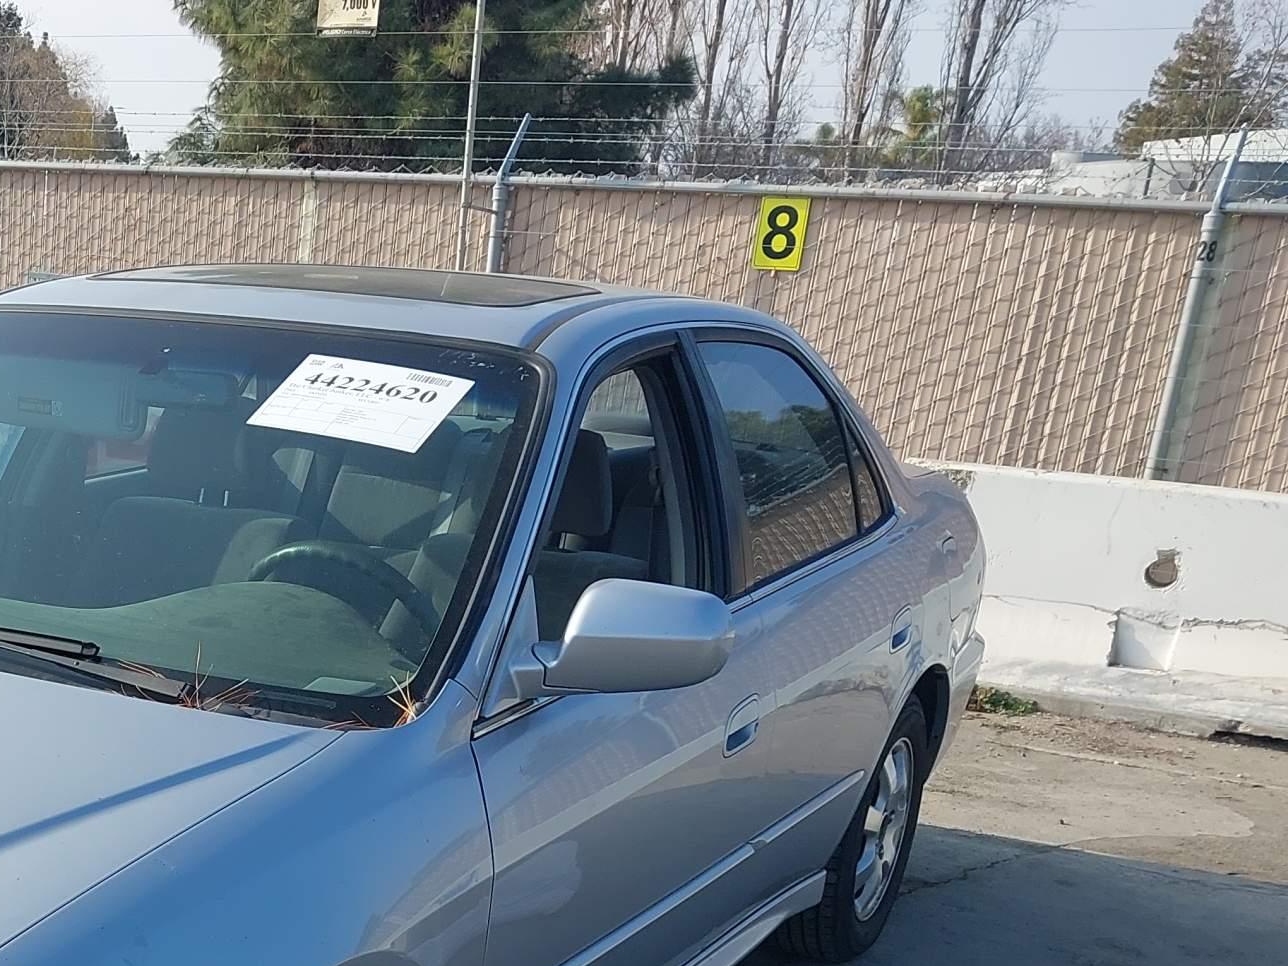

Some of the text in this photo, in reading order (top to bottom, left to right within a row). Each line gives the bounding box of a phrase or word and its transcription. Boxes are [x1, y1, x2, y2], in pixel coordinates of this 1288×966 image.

[762, 205, 799, 260] 8
[1197, 240, 1218, 262] 28
[304, 372, 439, 404] 44224620
